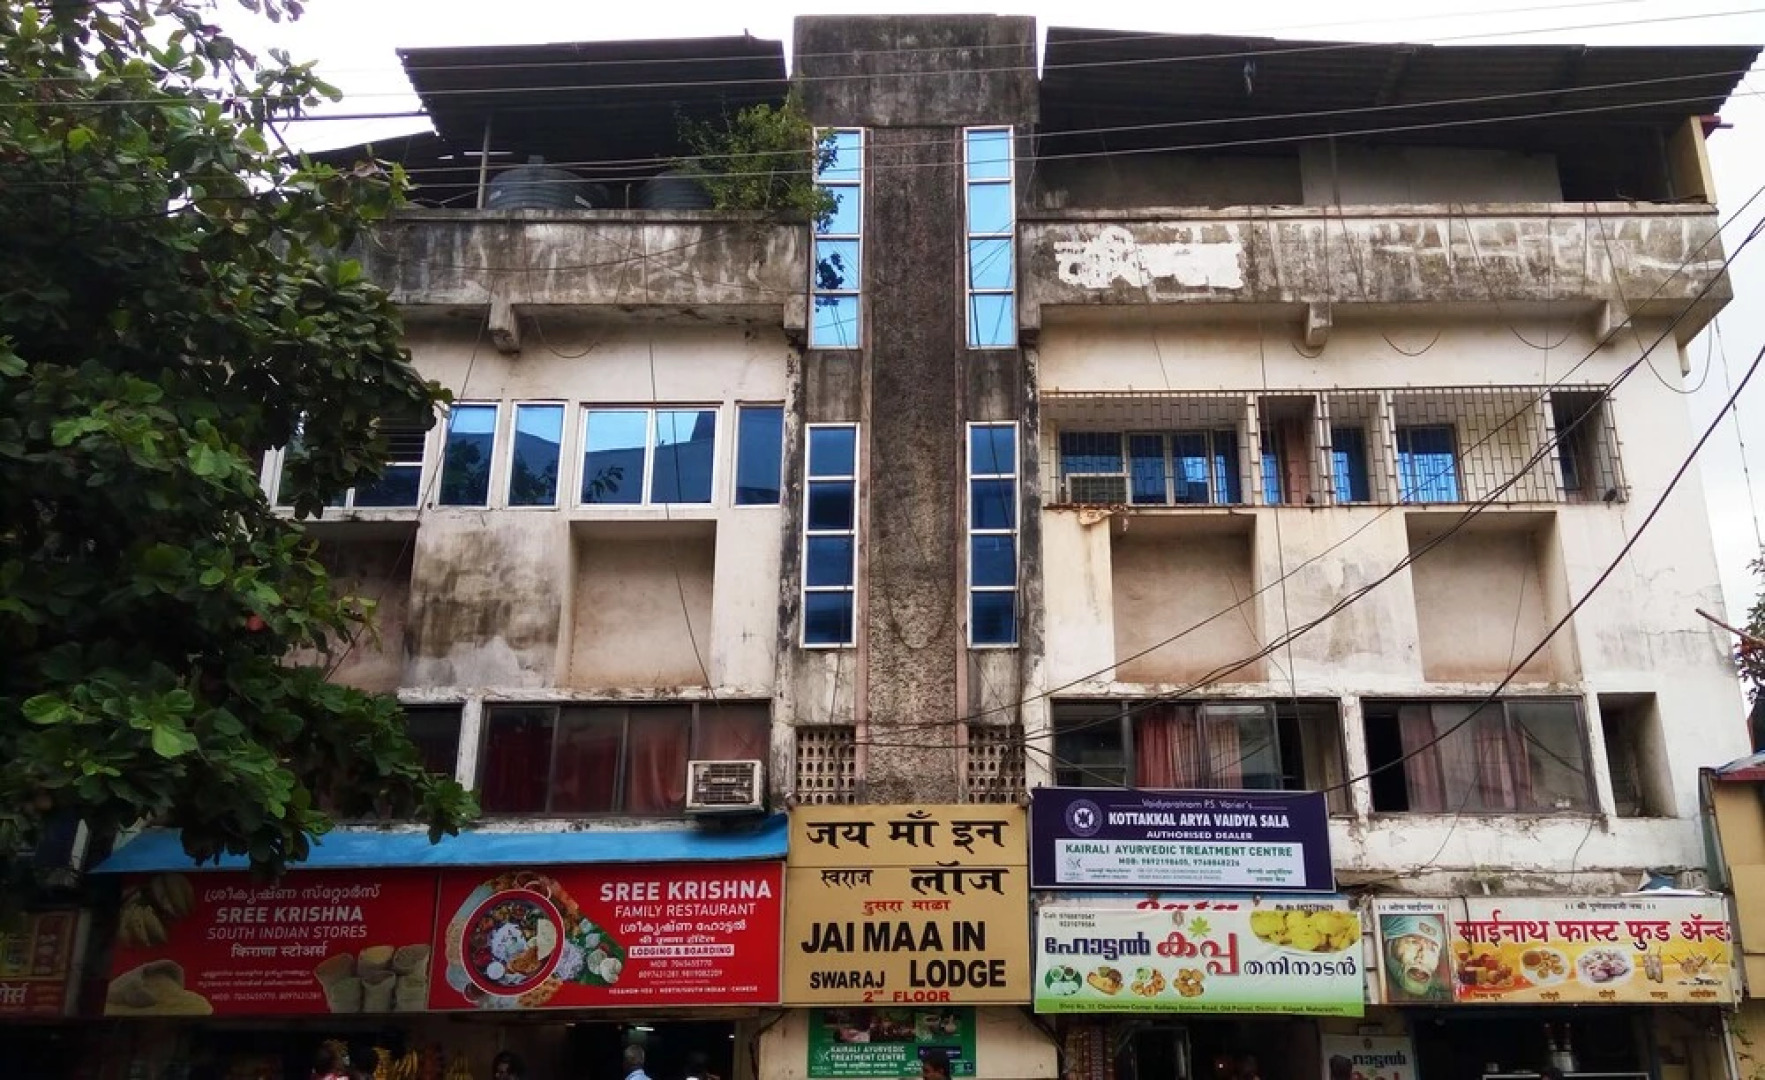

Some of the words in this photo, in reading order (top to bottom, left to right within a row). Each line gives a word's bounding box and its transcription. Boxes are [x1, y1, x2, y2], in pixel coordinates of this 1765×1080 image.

[1108, 811, 1176, 826] KOTTAKKAL
[1180, 812, 1211, 827] ARYA
[1213, 813, 1257, 828] VAIDYA
[1260, 813, 1289, 828] SALA
[806, 821, 876, 849] जय
[888, 809, 940, 848] माँ
[950, 820, 1009, 855] इन
[1146, 830, 1211, 840] AUTHORISED
[1215, 831, 1253, 840] DEALER
[1065, 843, 1109, 855] KAIRALI
[1114, 844, 1176, 856] AYURVEDIC
[1179, 845, 1246, 857] TREATMENT
[1249, 847, 1293, 858] CENTRE
[820, 869, 874, 889] स्वराज
[909, 860, 1009, 895] लॉज
[600, 881, 661, 902] SREE
[668, 878, 772, 901] KRISHNA
[216, 906, 269, 924] SREE
[274, 905, 364, 923] KRISHNA
[615, 904, 663, 918] FAMILY
[667, 902, 757, 917] RESTAURANT
[862, 899, 904, 916] दुसरा
[912, 899, 951, 912] माळा
[207, 927, 255, 940] SOUTH
[259, 926, 308, 939] INDIAN
[313, 925, 368, 939] STORES
[801, 921, 855, 953] JAI
[862, 920, 944, 953] MAA
[952, 920, 986, 952] IN
[1454, 909, 1551, 947] साईनाथ
[1554, 920, 1621, 943] फास्ट
[1624, 920, 1672, 950] फुड
[631, 947, 673, 956] LODGING
[684, 946, 732, 955] BOARDING
[1156, 931, 1240, 976] കപ്പ
[810, 970, 885, 989] SWARAJ
[910, 959, 1007, 988] LODGE
[1244, 955, 1356, 977] തനിനാടൻ
[893, 992, 951, 1003] FLOOR
[830, 1053, 875, 1062] TREATMENT
[876, 1053, 906, 1062] CENTRE
